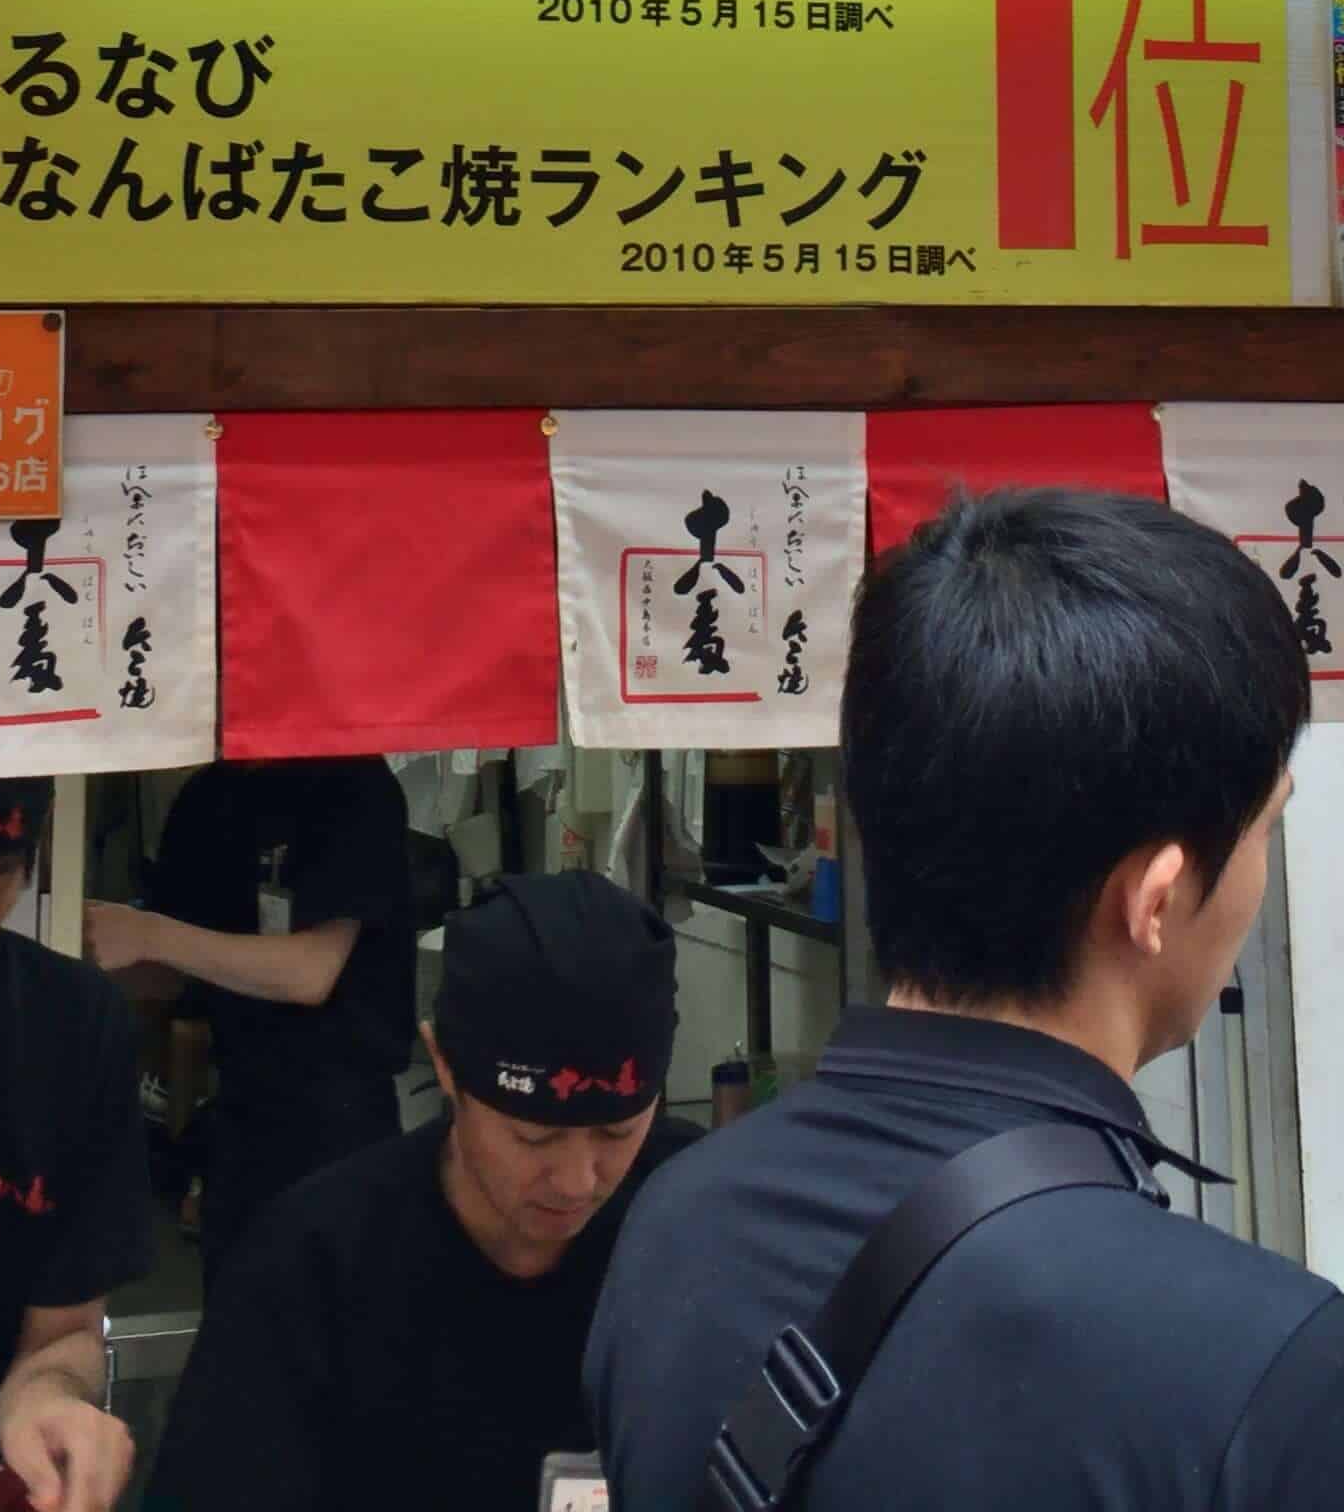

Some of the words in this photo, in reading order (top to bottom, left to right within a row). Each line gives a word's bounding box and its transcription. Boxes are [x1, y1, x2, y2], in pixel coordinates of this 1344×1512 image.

[0, 140, 927, 232] なんばたこ焼ランキング
[619, 240, 978, 278] 2010年5月15日調べ
